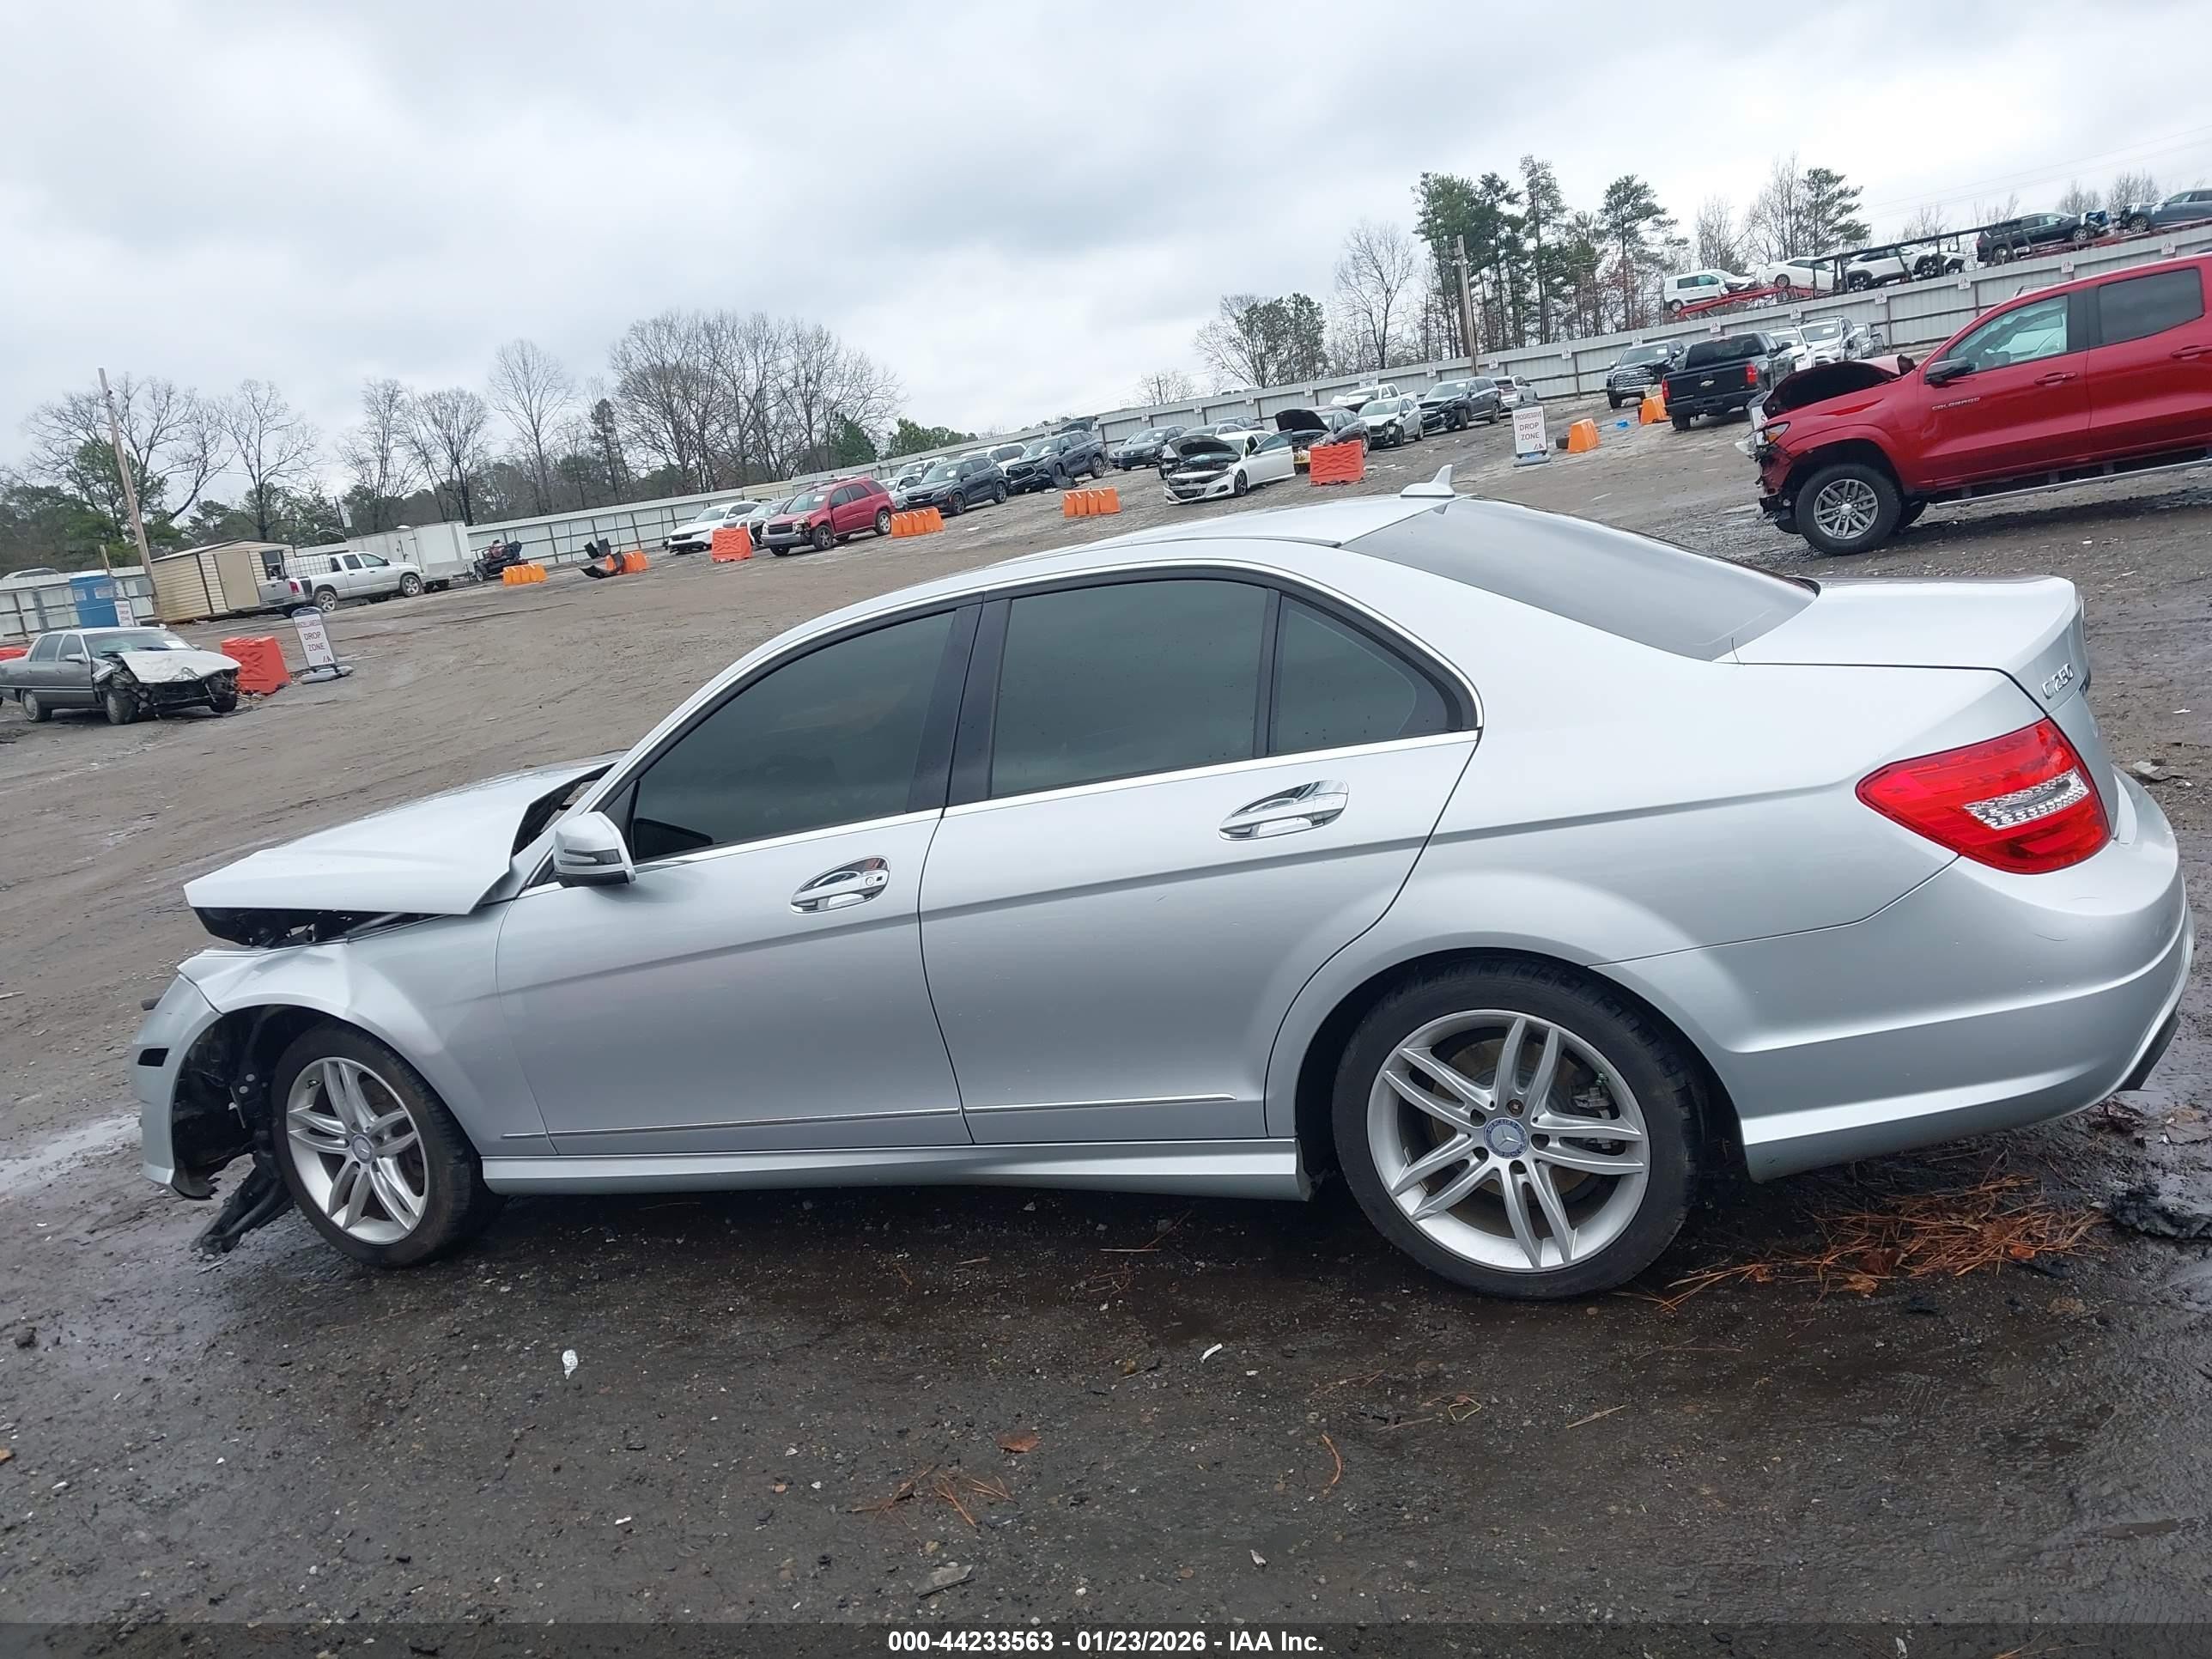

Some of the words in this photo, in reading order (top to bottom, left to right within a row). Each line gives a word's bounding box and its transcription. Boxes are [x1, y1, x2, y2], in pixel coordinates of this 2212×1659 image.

[1931, 397, 1981, 410] COLORADO
[1519, 422, 1540, 431] DROP
[1520, 431, 1540, 441] ZONE
[303, 631, 322, 641] DROP
[307, 641, 326, 652] ZONE
